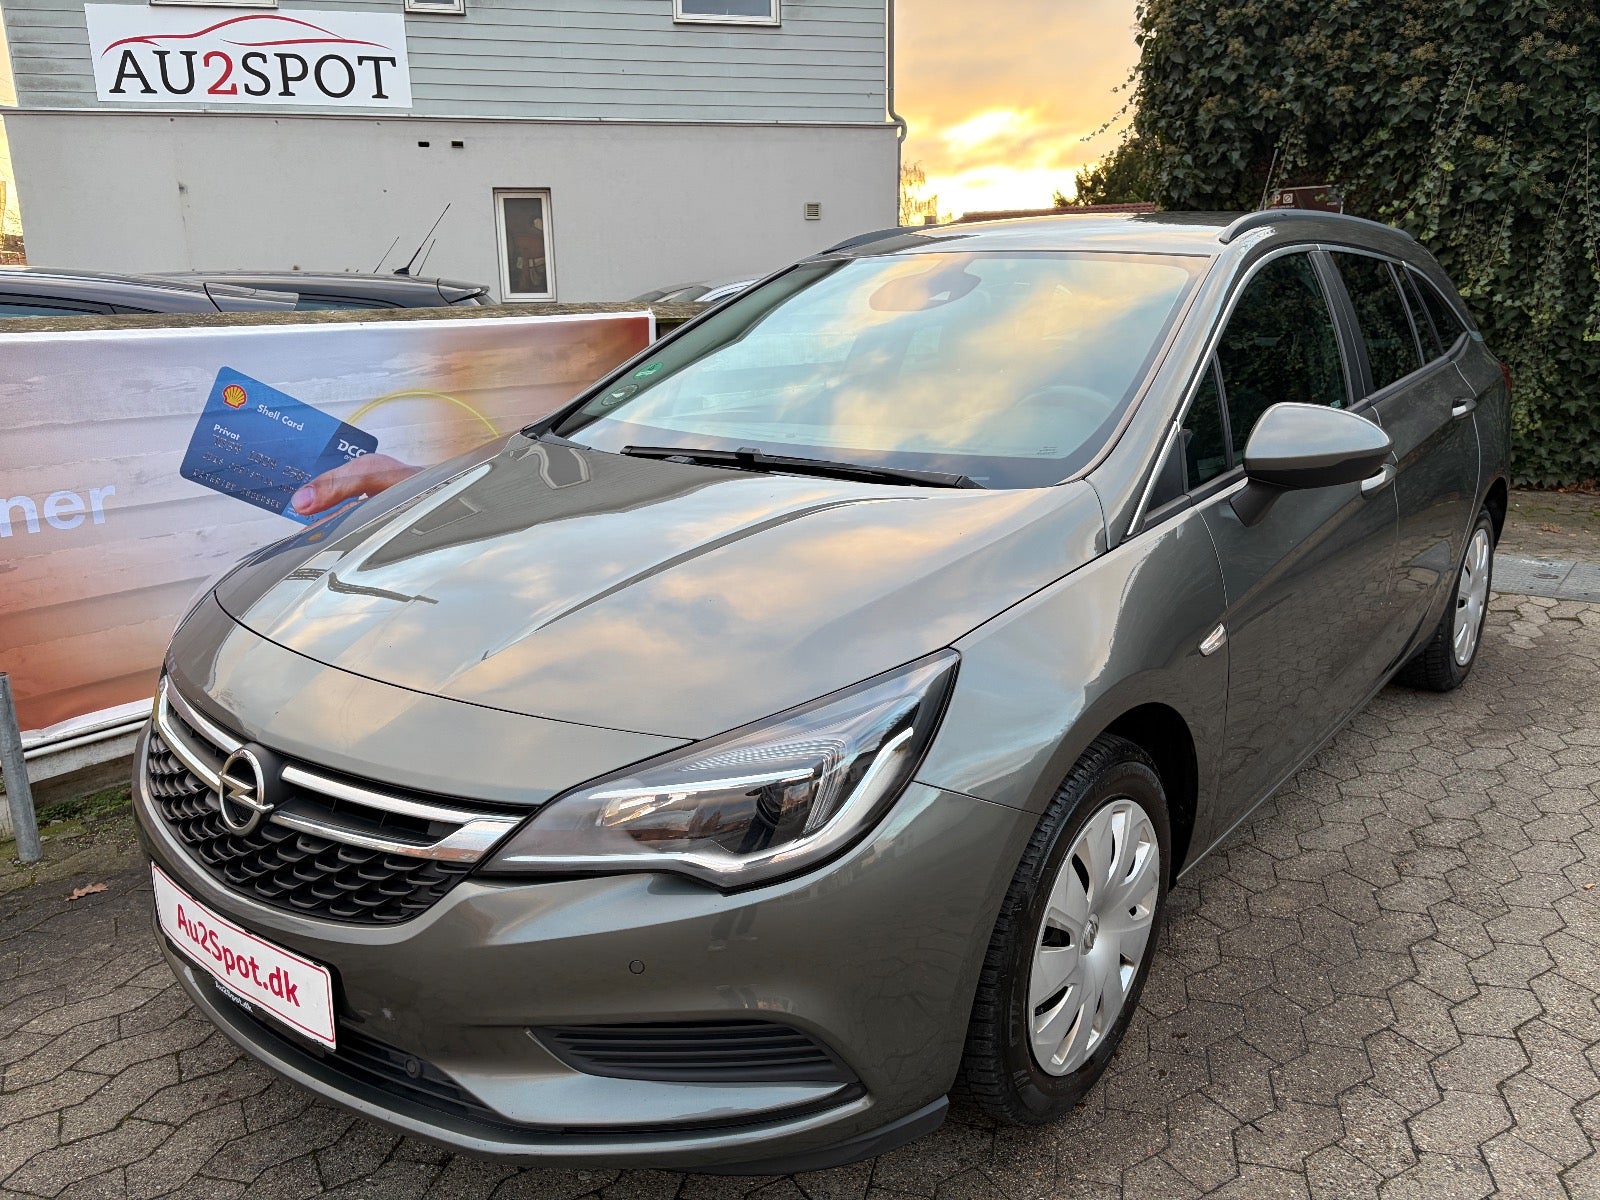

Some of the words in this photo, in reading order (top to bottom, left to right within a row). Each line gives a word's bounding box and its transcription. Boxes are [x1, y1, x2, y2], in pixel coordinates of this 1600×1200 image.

[109, 49, 398, 100] AU2SPOT
[213, 423, 241, 441] Privat
[256, 403, 281, 422] Shell
[281, 415, 305, 432] Card
[177, 902, 301, 1008] Au2Spot.dk
